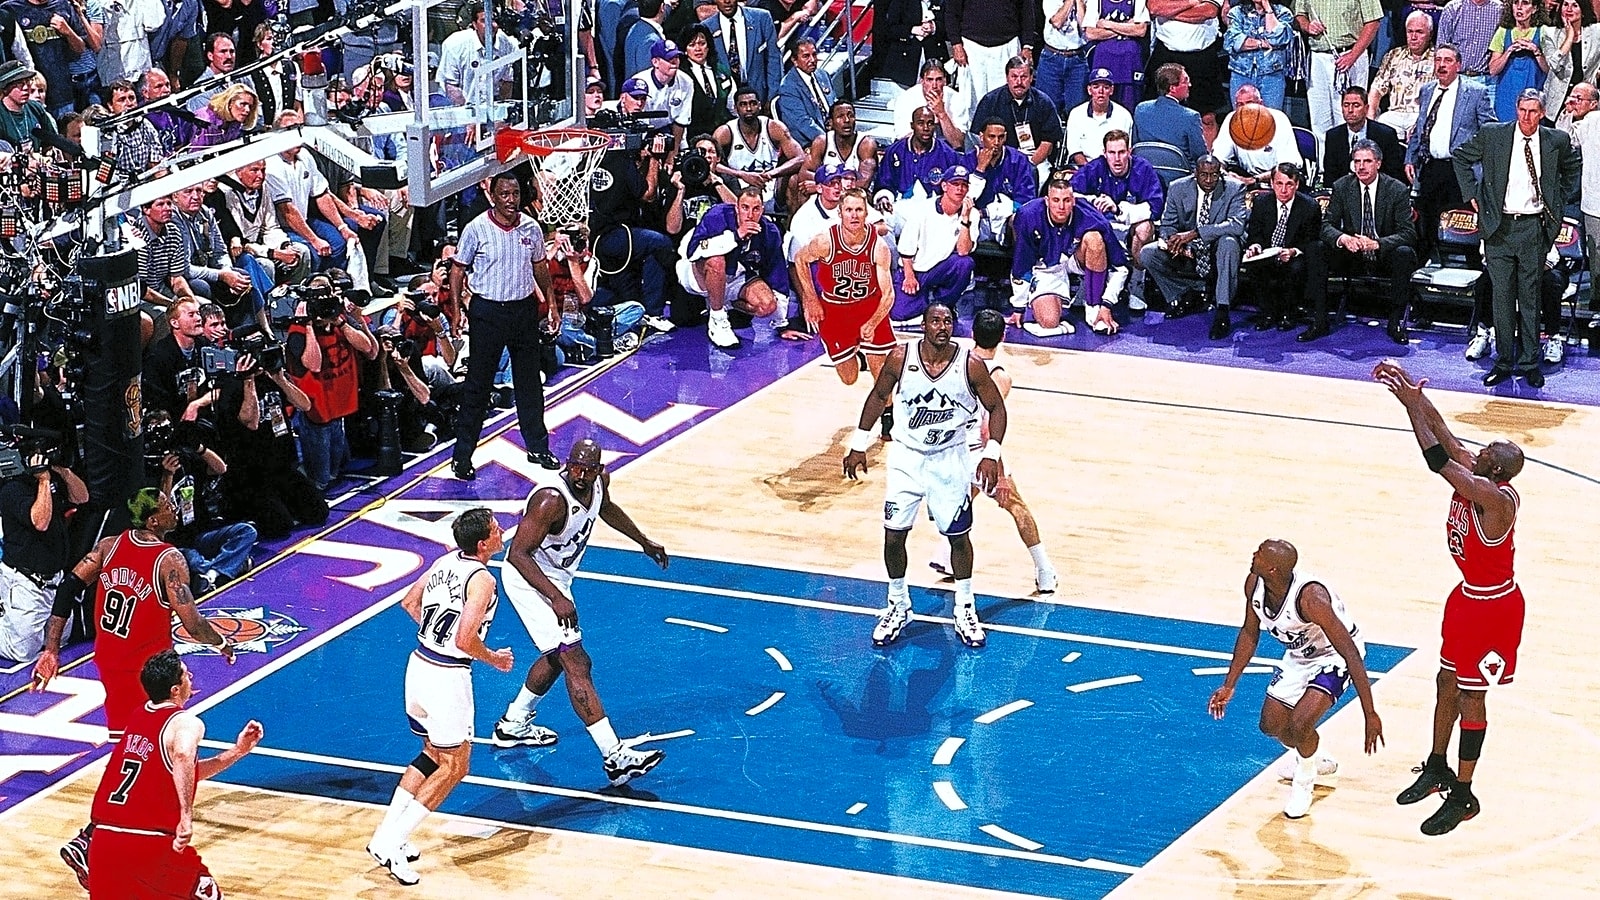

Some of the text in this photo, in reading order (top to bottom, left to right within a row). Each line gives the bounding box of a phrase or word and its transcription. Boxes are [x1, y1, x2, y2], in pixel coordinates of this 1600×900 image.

[1448, 220, 1477, 230] Finals
[1451, 213, 1473, 222] NBA
[832, 259, 872, 279] BULLS
[834, 276, 870, 300] 25
[909, 407, 956, 430] JAZZ
[100, 567, 153, 602] RODMAN
[100, 588, 138, 639] 91
[418, 602, 462, 648] 14
[107, 758, 143, 806] 7
